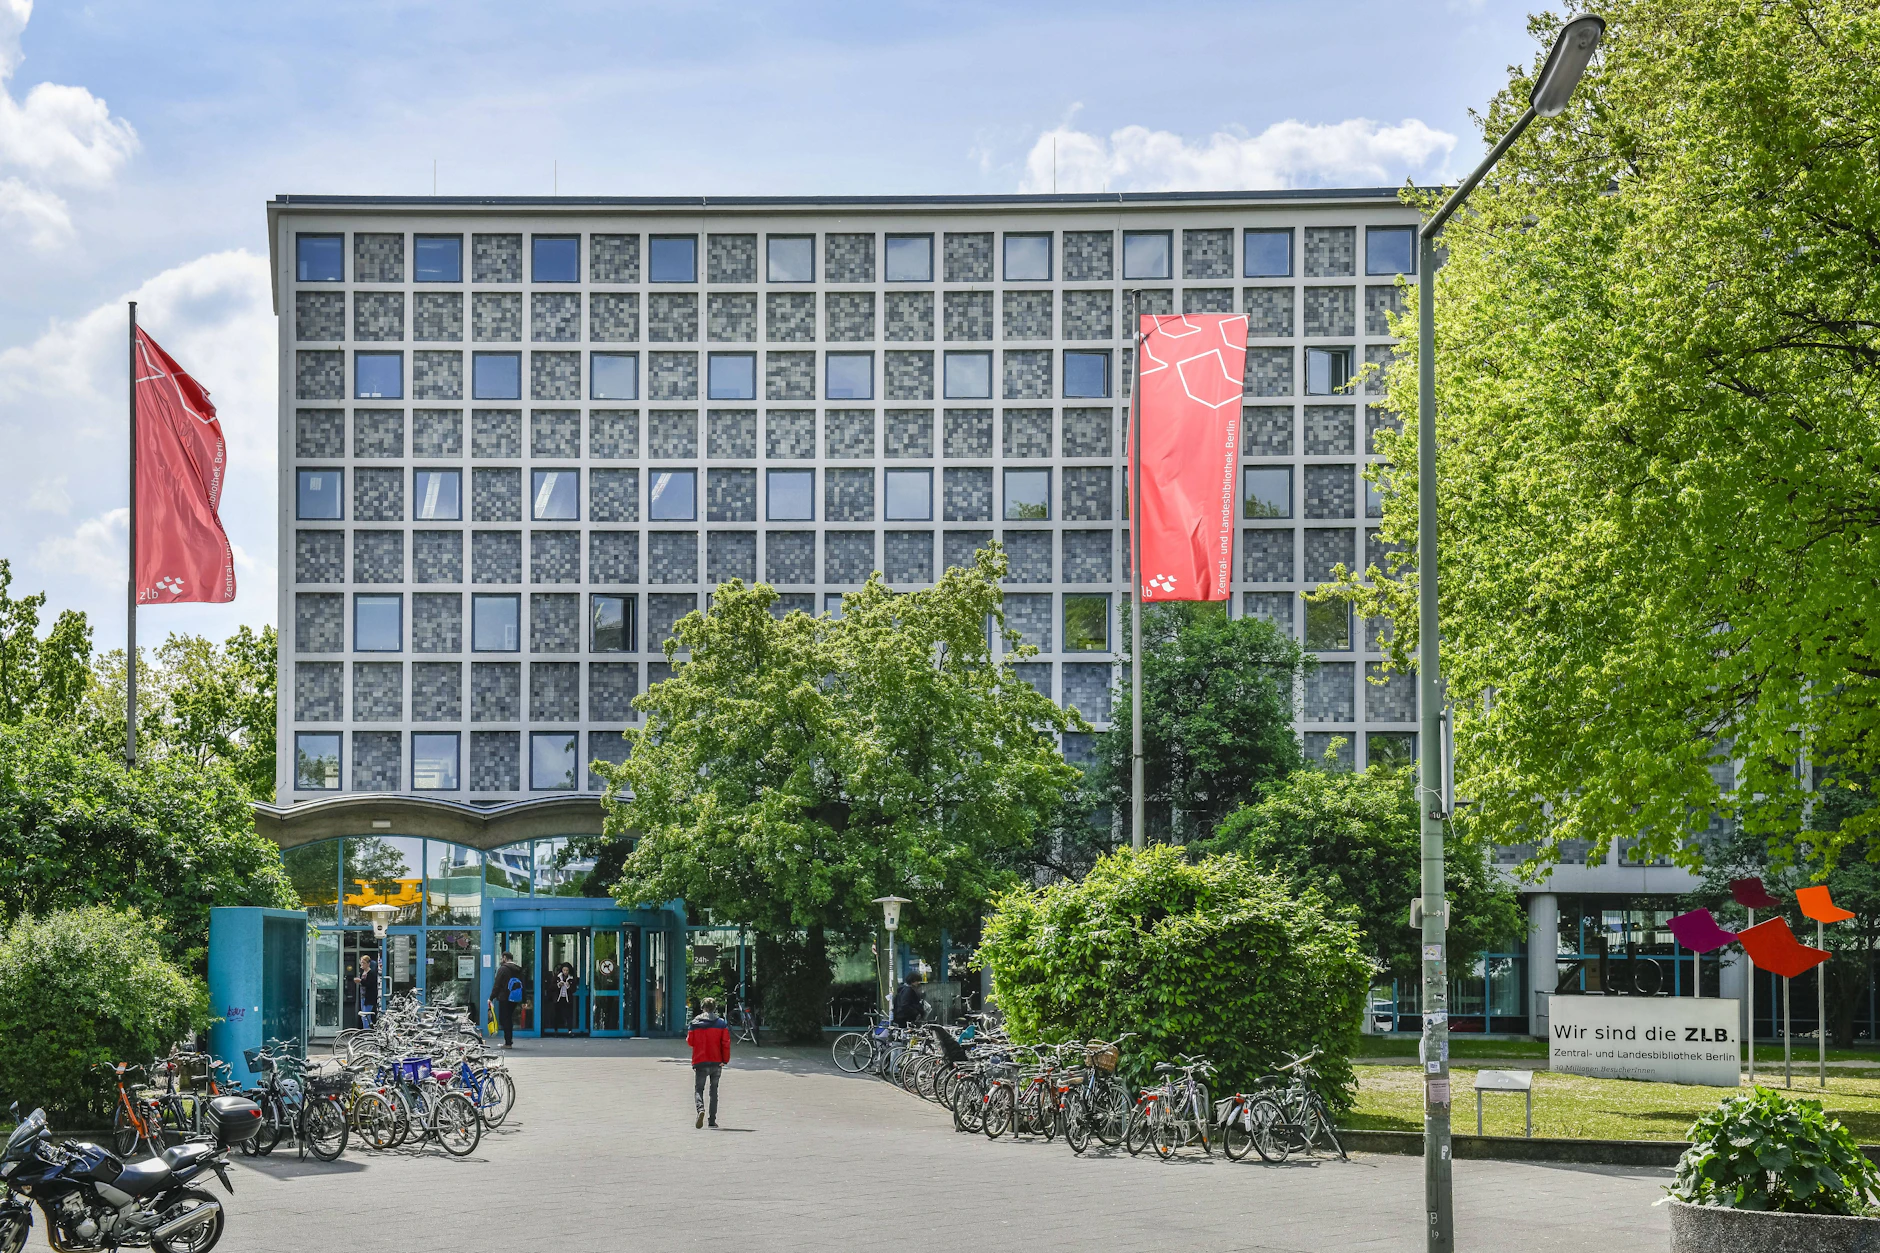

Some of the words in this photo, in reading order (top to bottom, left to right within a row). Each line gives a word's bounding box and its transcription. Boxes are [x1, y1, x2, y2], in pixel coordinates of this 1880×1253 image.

[1225, 420, 1236, 448] Berlin
[1220, 451, 1233, 533] Landesbibliothek
[1220, 536, 1229, 554] und
[224, 562, 233, 598] Zentral-
[1218, 557, 1228, 595] Zentral-
[140, 587, 159, 600] zlb
[1141, 585, 1153, 598] lb
[431, 940, 449, 952] zlb
[1554, 1024, 1588, 1039] Wir
[1595, 1025, 1636, 1040] sind
[1645, 1026, 1676, 1041] die
[1684, 1027, 1735, 1043] ZLB.
[1554, 1048, 1593, 1058] Zentral-
[1595, 1050, 1614, 1059] und
[1617, 1050, 1703, 1061] Landesbibliothek
[1705, 1052, 1736, 1062] Berlin
[1554, 1064, 1564, 1072] 30
